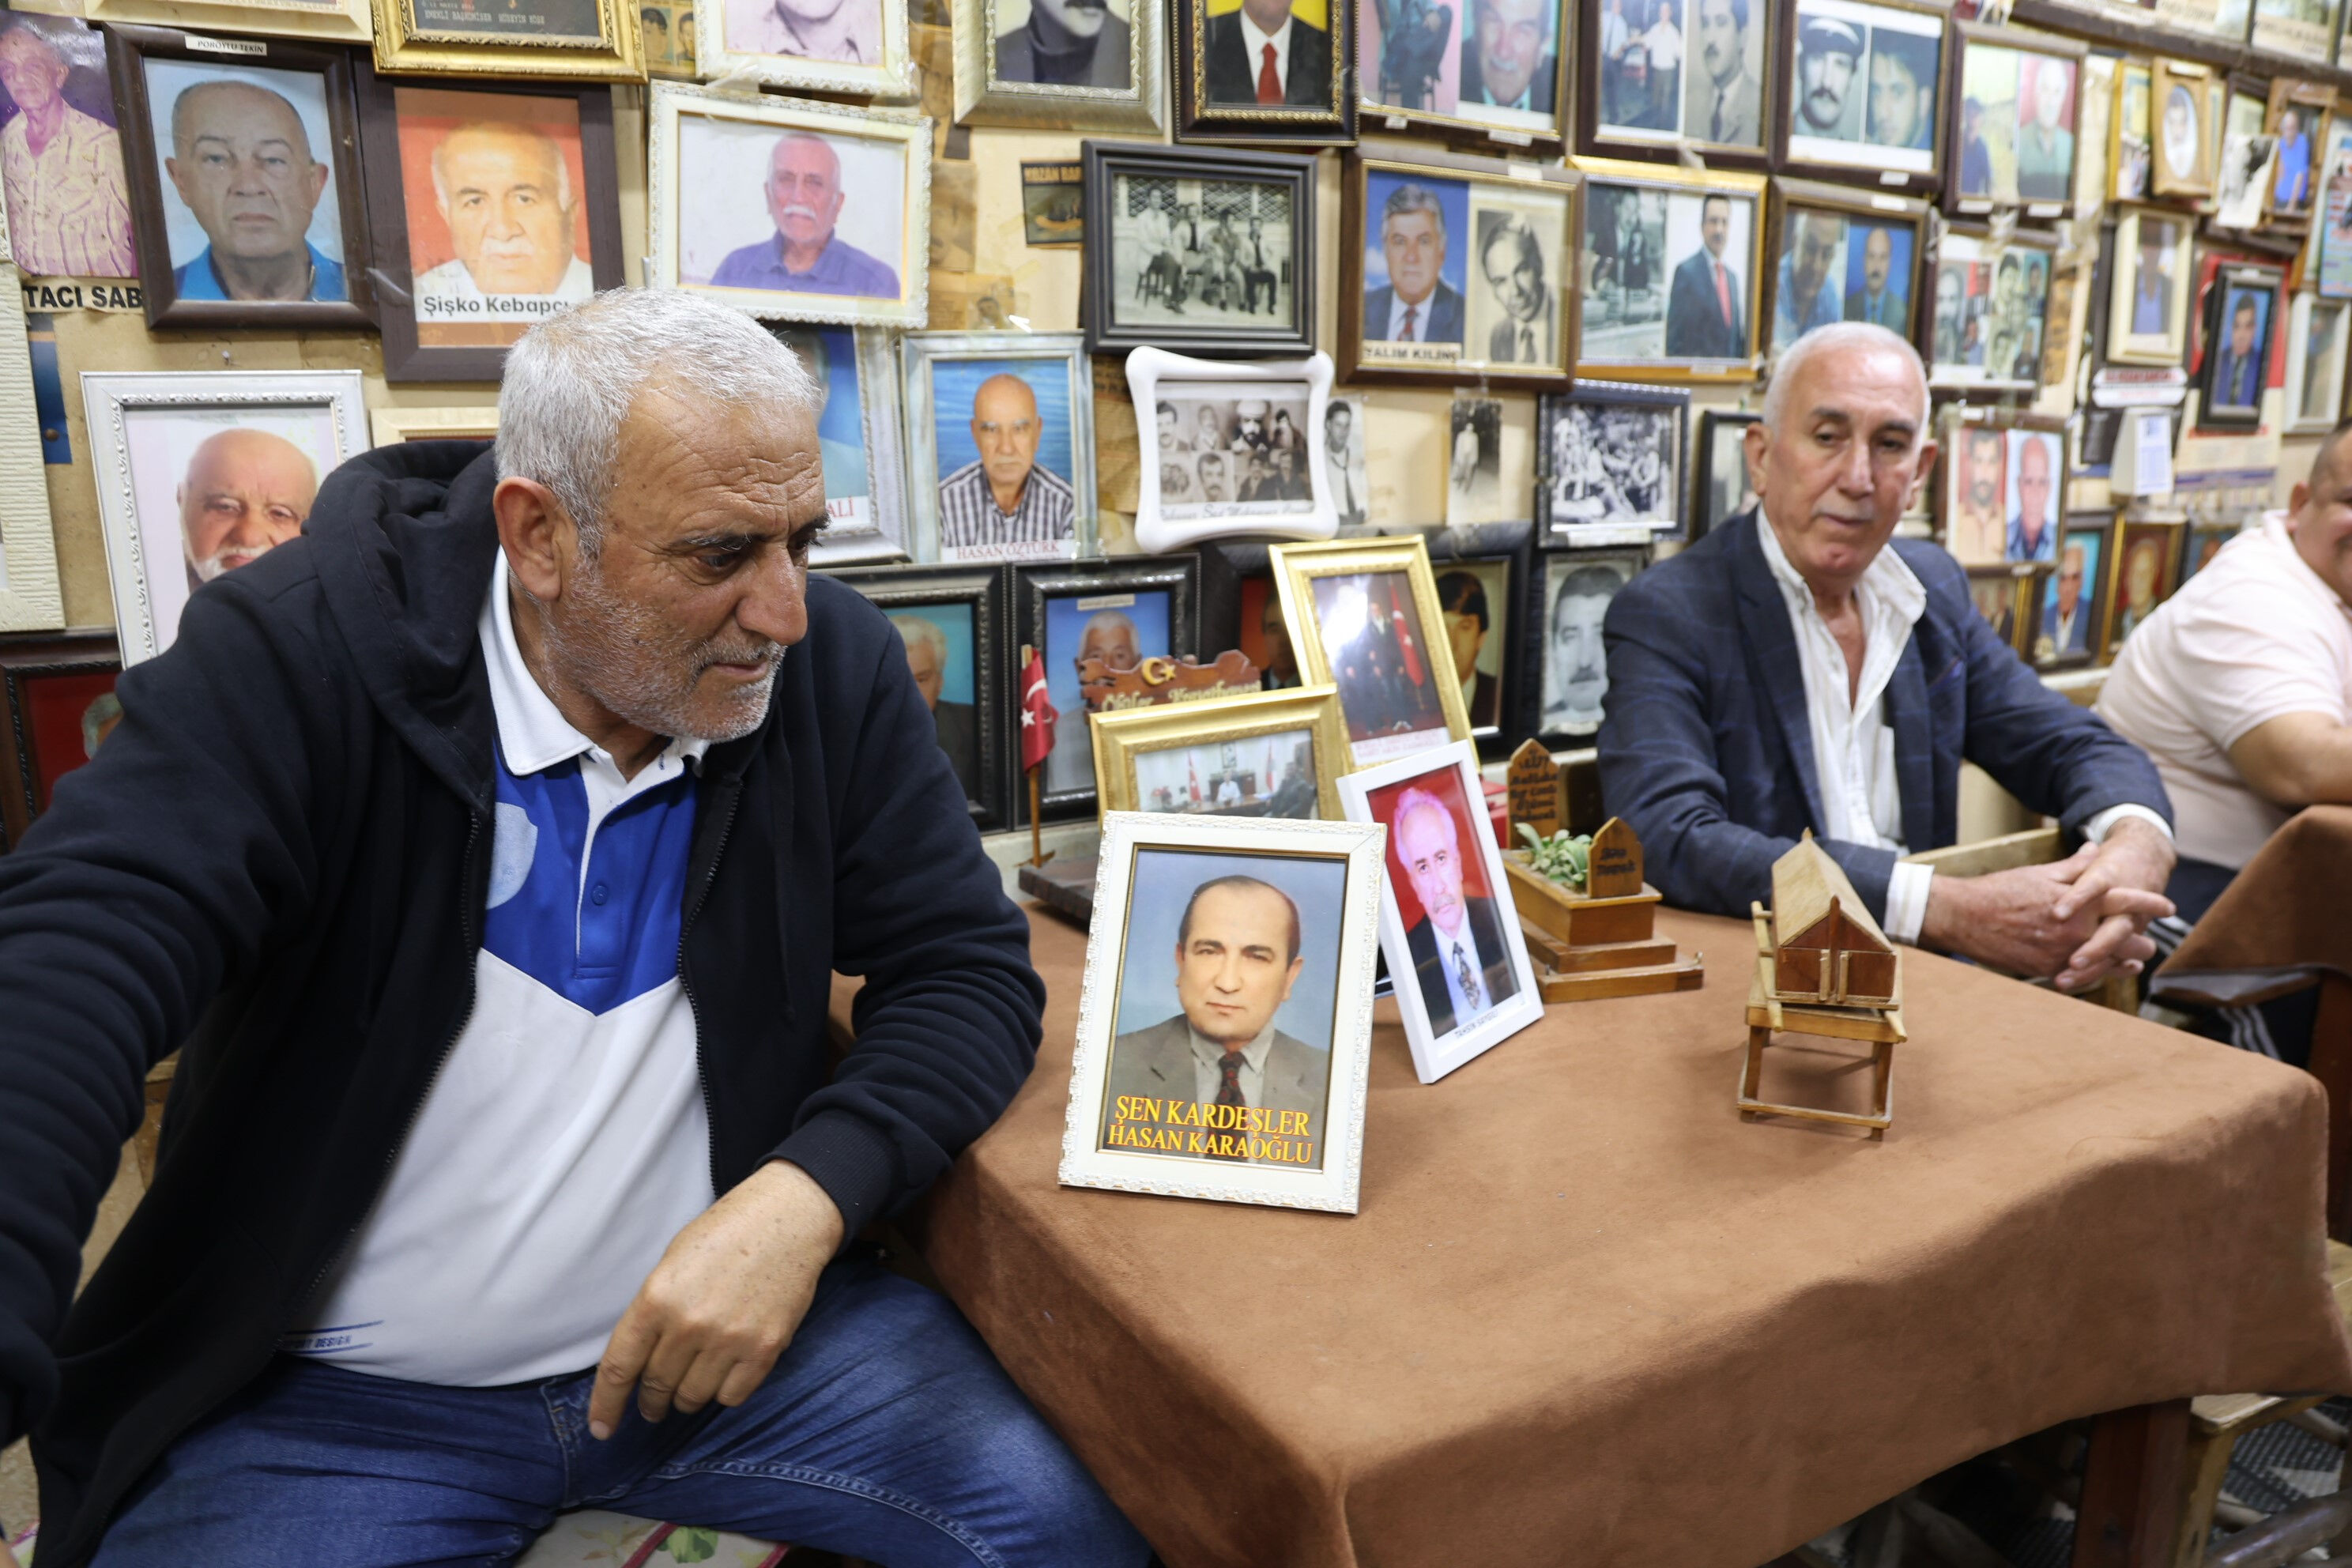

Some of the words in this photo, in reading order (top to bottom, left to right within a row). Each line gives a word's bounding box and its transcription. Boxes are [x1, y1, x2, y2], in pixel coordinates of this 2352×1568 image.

[23, 285, 84, 308] TACI
[424, 296, 481, 316] Şişko
[957, 546, 1004, 560] HASAN
[1006, 540, 1060, 557] ÖZTÜRK
[1114, 1095, 1163, 1125] ŞEN
[1165, 1099, 1311, 1138] KARDEŞLER
[1106, 1125, 1185, 1152] HASAN
[1187, 1132, 1314, 1164] KARAOĞLU
